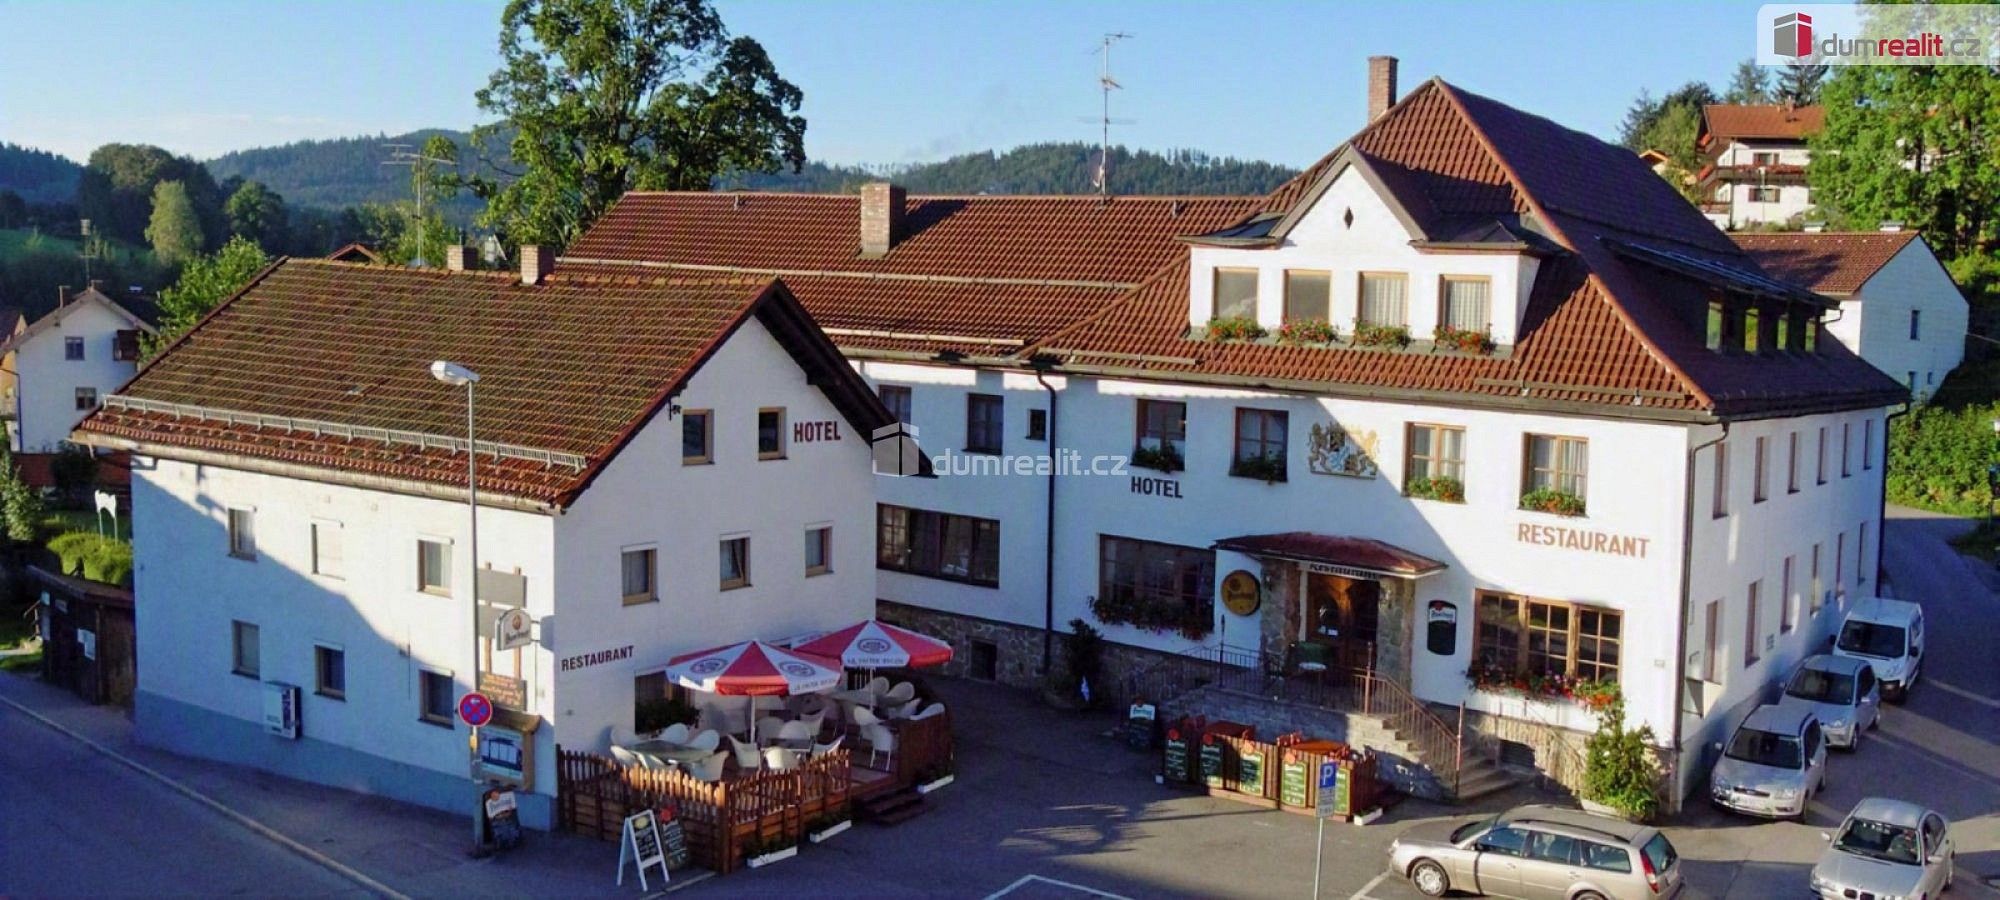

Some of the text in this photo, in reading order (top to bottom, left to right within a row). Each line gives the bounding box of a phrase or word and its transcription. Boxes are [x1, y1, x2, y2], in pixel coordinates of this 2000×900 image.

[794, 421, 841, 443] HOTEL
[1131, 476, 1183, 499] HOTEL
[1517, 522, 1651, 559] RESTAURANT
[561, 645, 634, 672] RESTAURANT
[1322, 765, 1334, 786] P
